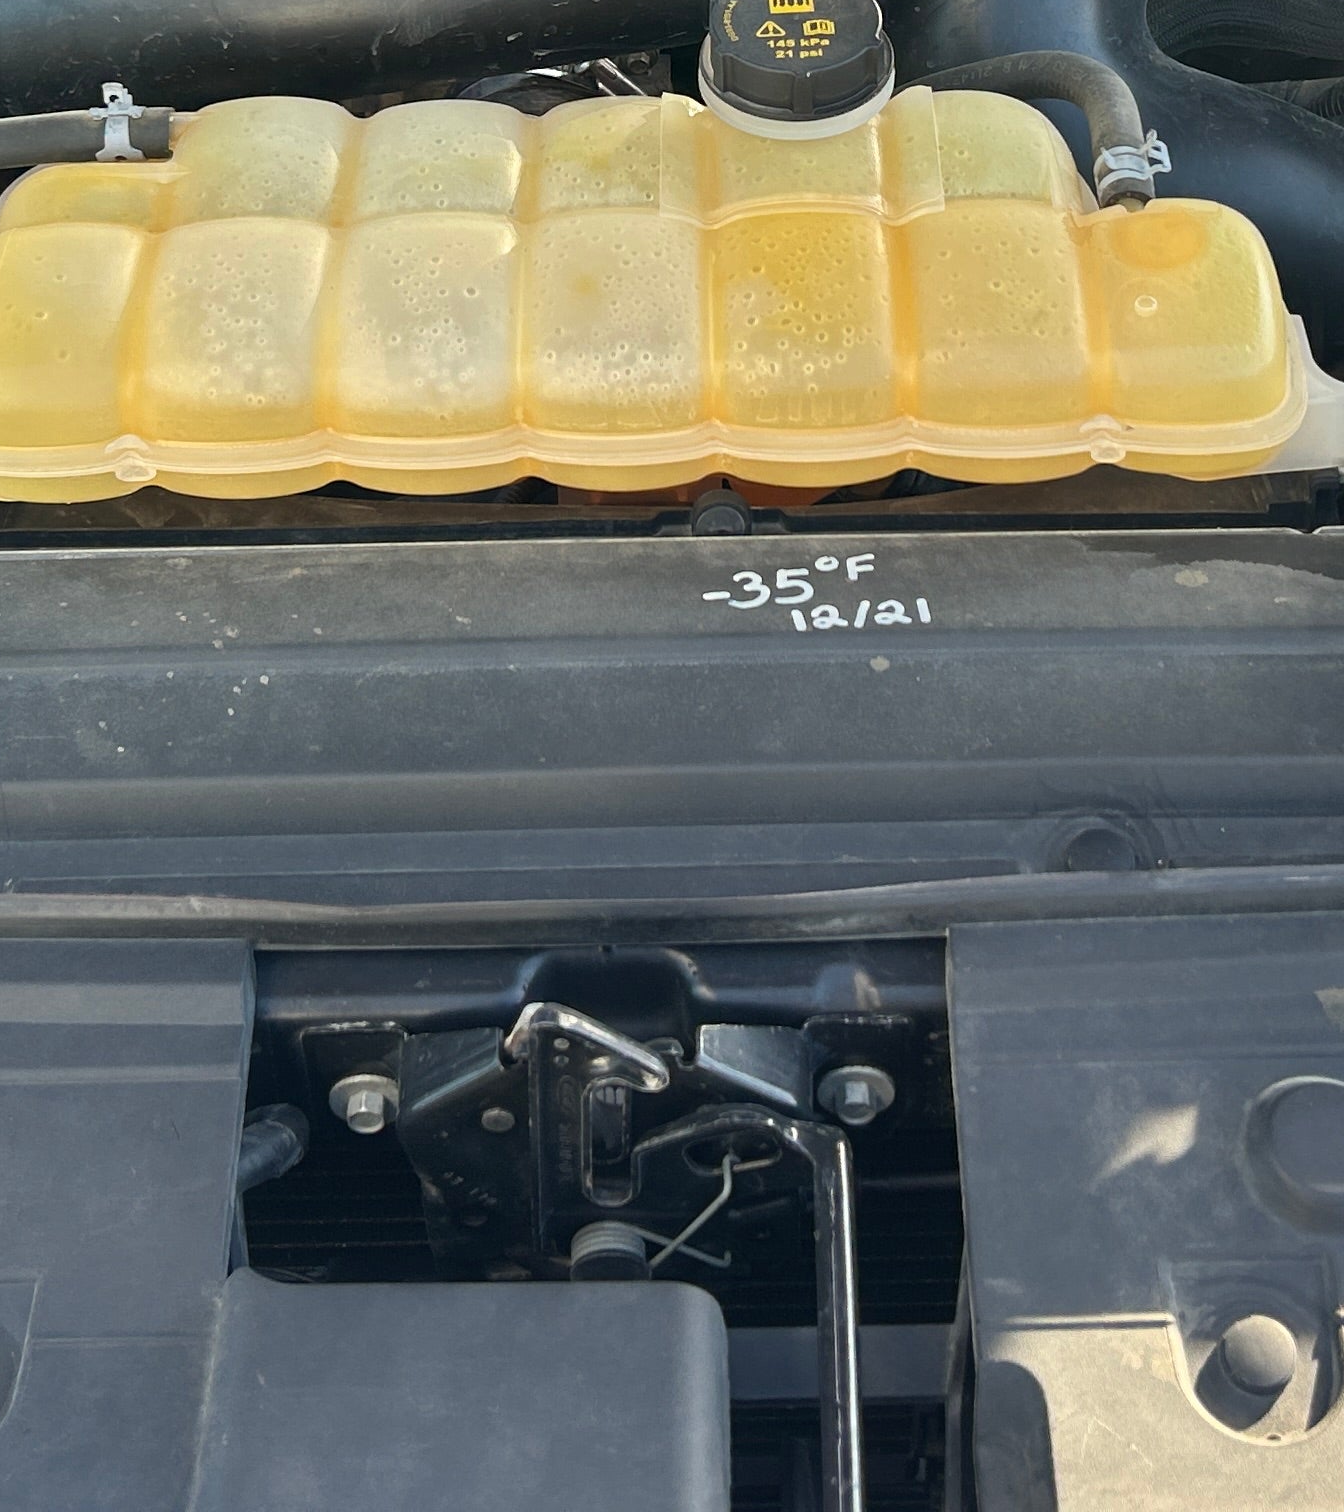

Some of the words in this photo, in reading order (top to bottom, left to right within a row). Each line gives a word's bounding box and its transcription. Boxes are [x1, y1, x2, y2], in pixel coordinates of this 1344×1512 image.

[766, 39, 796, 49] 145
[800, 38, 830, 48] kPa
[775, 50, 794, 59] 21
[799, 48, 824, 59] psi
[789, 596, 933, 633] 12/21
